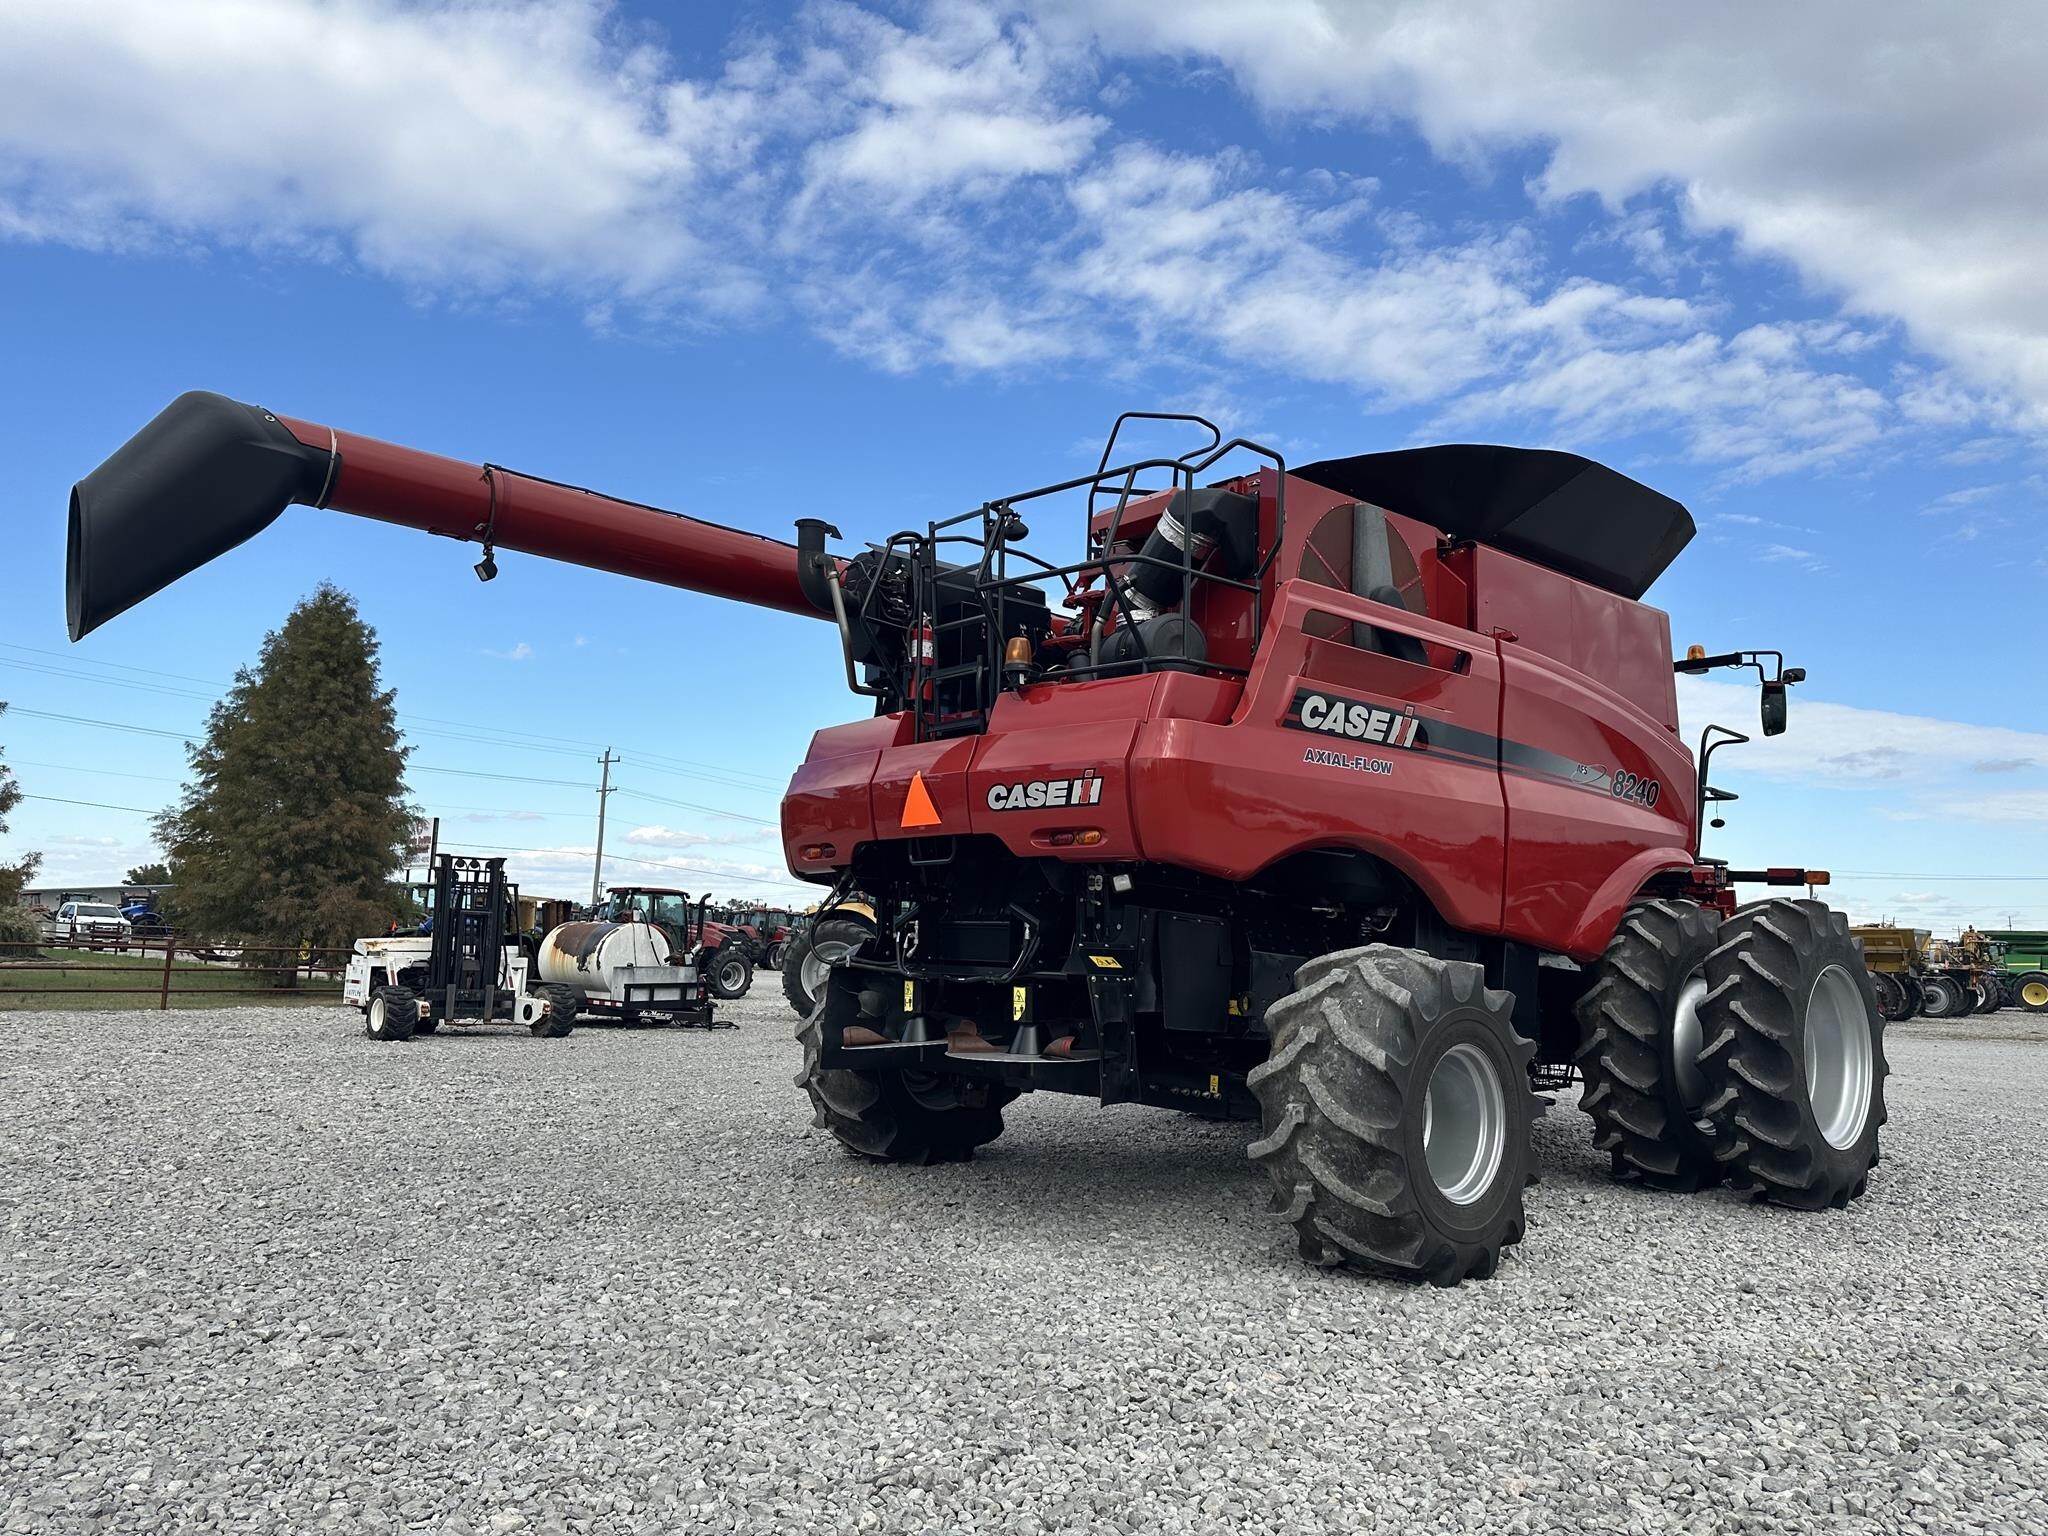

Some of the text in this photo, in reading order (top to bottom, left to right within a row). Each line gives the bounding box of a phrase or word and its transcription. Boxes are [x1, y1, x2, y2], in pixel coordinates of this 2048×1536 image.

[1301, 695, 1391, 741] CASE
[1304, 748, 1393, 775] AXIAL-FLOW
[987, 782, 1068, 810] CASE
[1612, 769, 1660, 808] 8240
